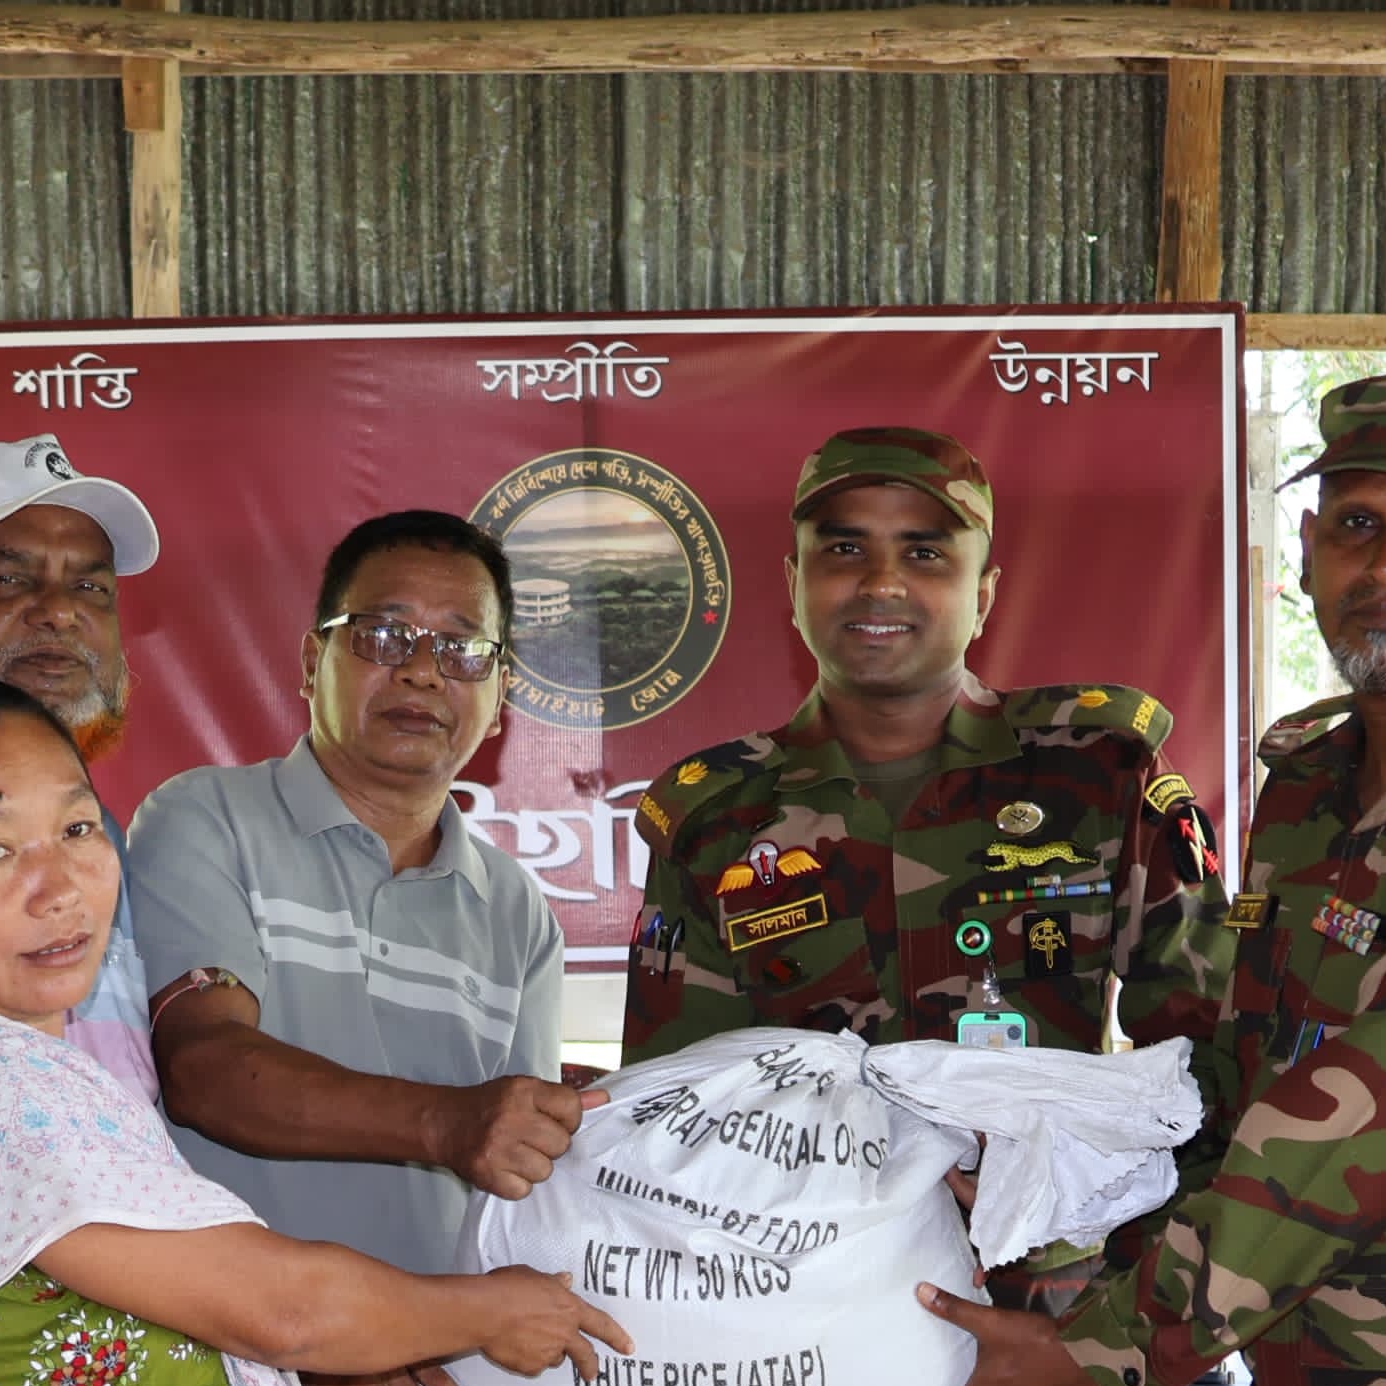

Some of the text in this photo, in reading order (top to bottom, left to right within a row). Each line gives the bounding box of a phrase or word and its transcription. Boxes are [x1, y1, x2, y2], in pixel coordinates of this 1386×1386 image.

[12, 352, 139, 409] শান্তি
[476, 341, 670, 402] সম্প্রীতি
[988, 335, 1160, 404] উন্নয়ন
[569, 459, 599, 480] দেশ
[630, 667, 684, 713] জোন
[746, 907, 808, 937] সালমান
[583, 1239, 792, 1302] NET WT. 50 KGS
